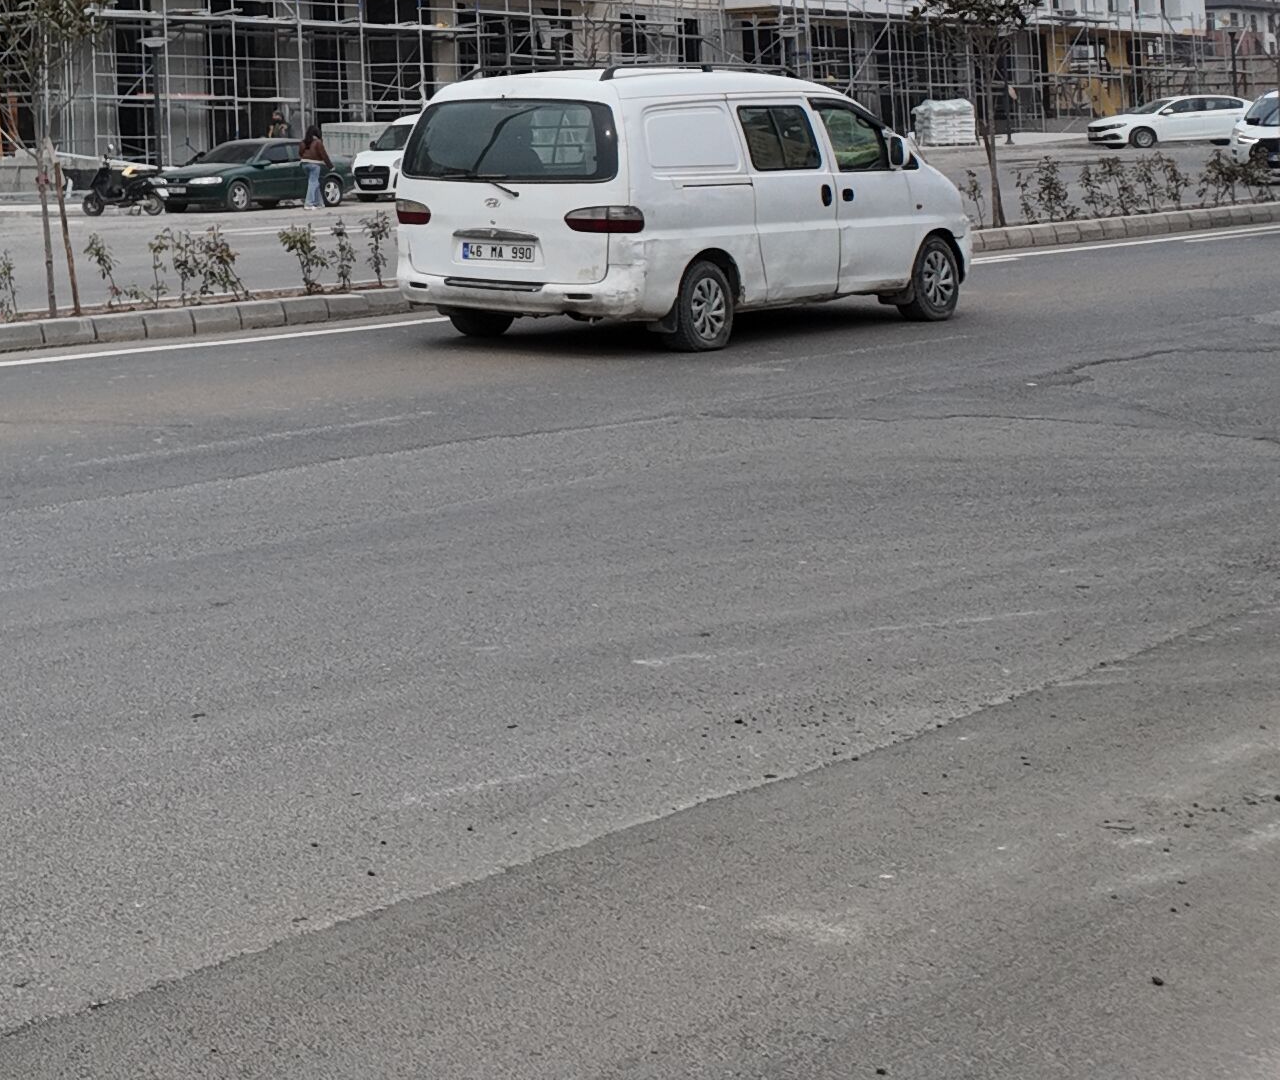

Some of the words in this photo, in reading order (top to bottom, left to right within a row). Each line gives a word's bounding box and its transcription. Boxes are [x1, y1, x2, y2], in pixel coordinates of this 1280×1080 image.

[470, 245, 482, 257] 46
[491, 246, 503, 258] MA
[512, 247, 531, 259] 990
